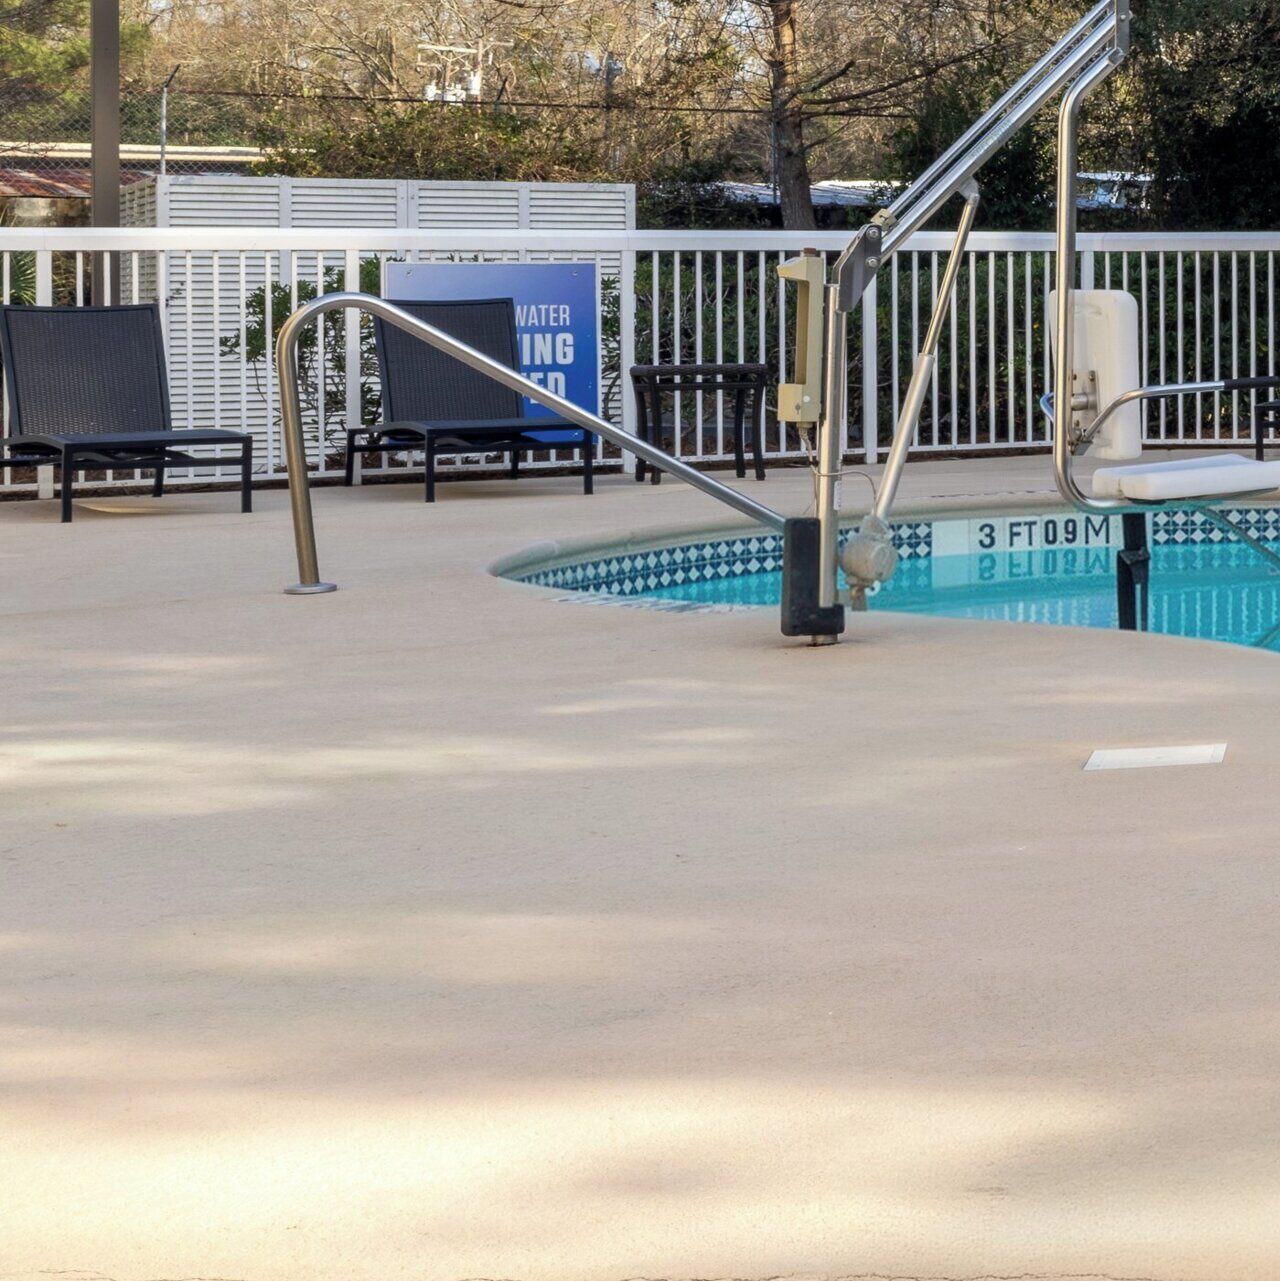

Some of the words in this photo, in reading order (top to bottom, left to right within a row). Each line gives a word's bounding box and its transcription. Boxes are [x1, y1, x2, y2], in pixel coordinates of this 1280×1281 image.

[516, 305, 570, 326] WATER
[520, 333, 574, 365] ING
[979, 523, 995, 548] 3
[1009, 521, 1037, 547] FT
[1044, 519, 1077, 544] 0.9
[1085, 516, 1109, 544] M
